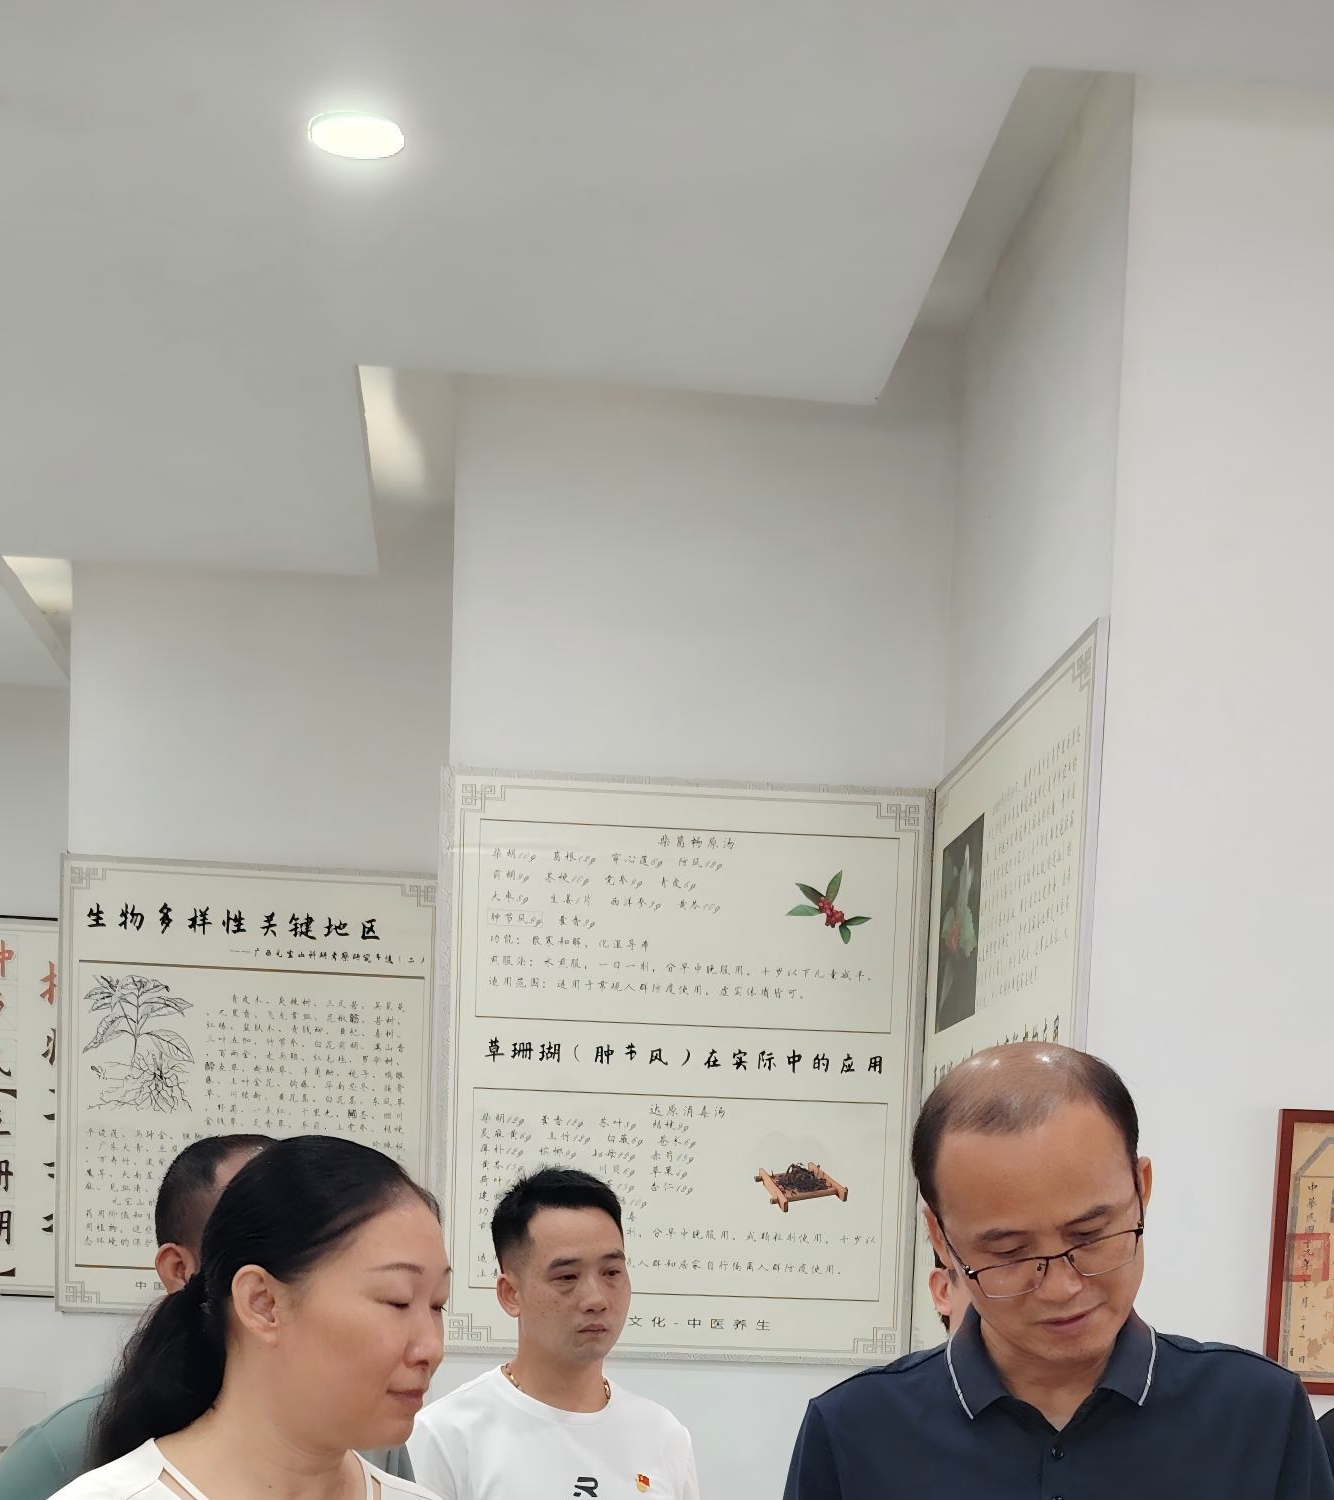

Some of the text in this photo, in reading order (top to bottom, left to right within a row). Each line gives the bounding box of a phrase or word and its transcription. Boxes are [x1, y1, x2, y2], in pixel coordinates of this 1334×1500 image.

[86, 902, 381, 942] 生物多样性关键地区
[484, 1036, 884, 1076] 草珊瑚(肿节风)在实际中的应用
